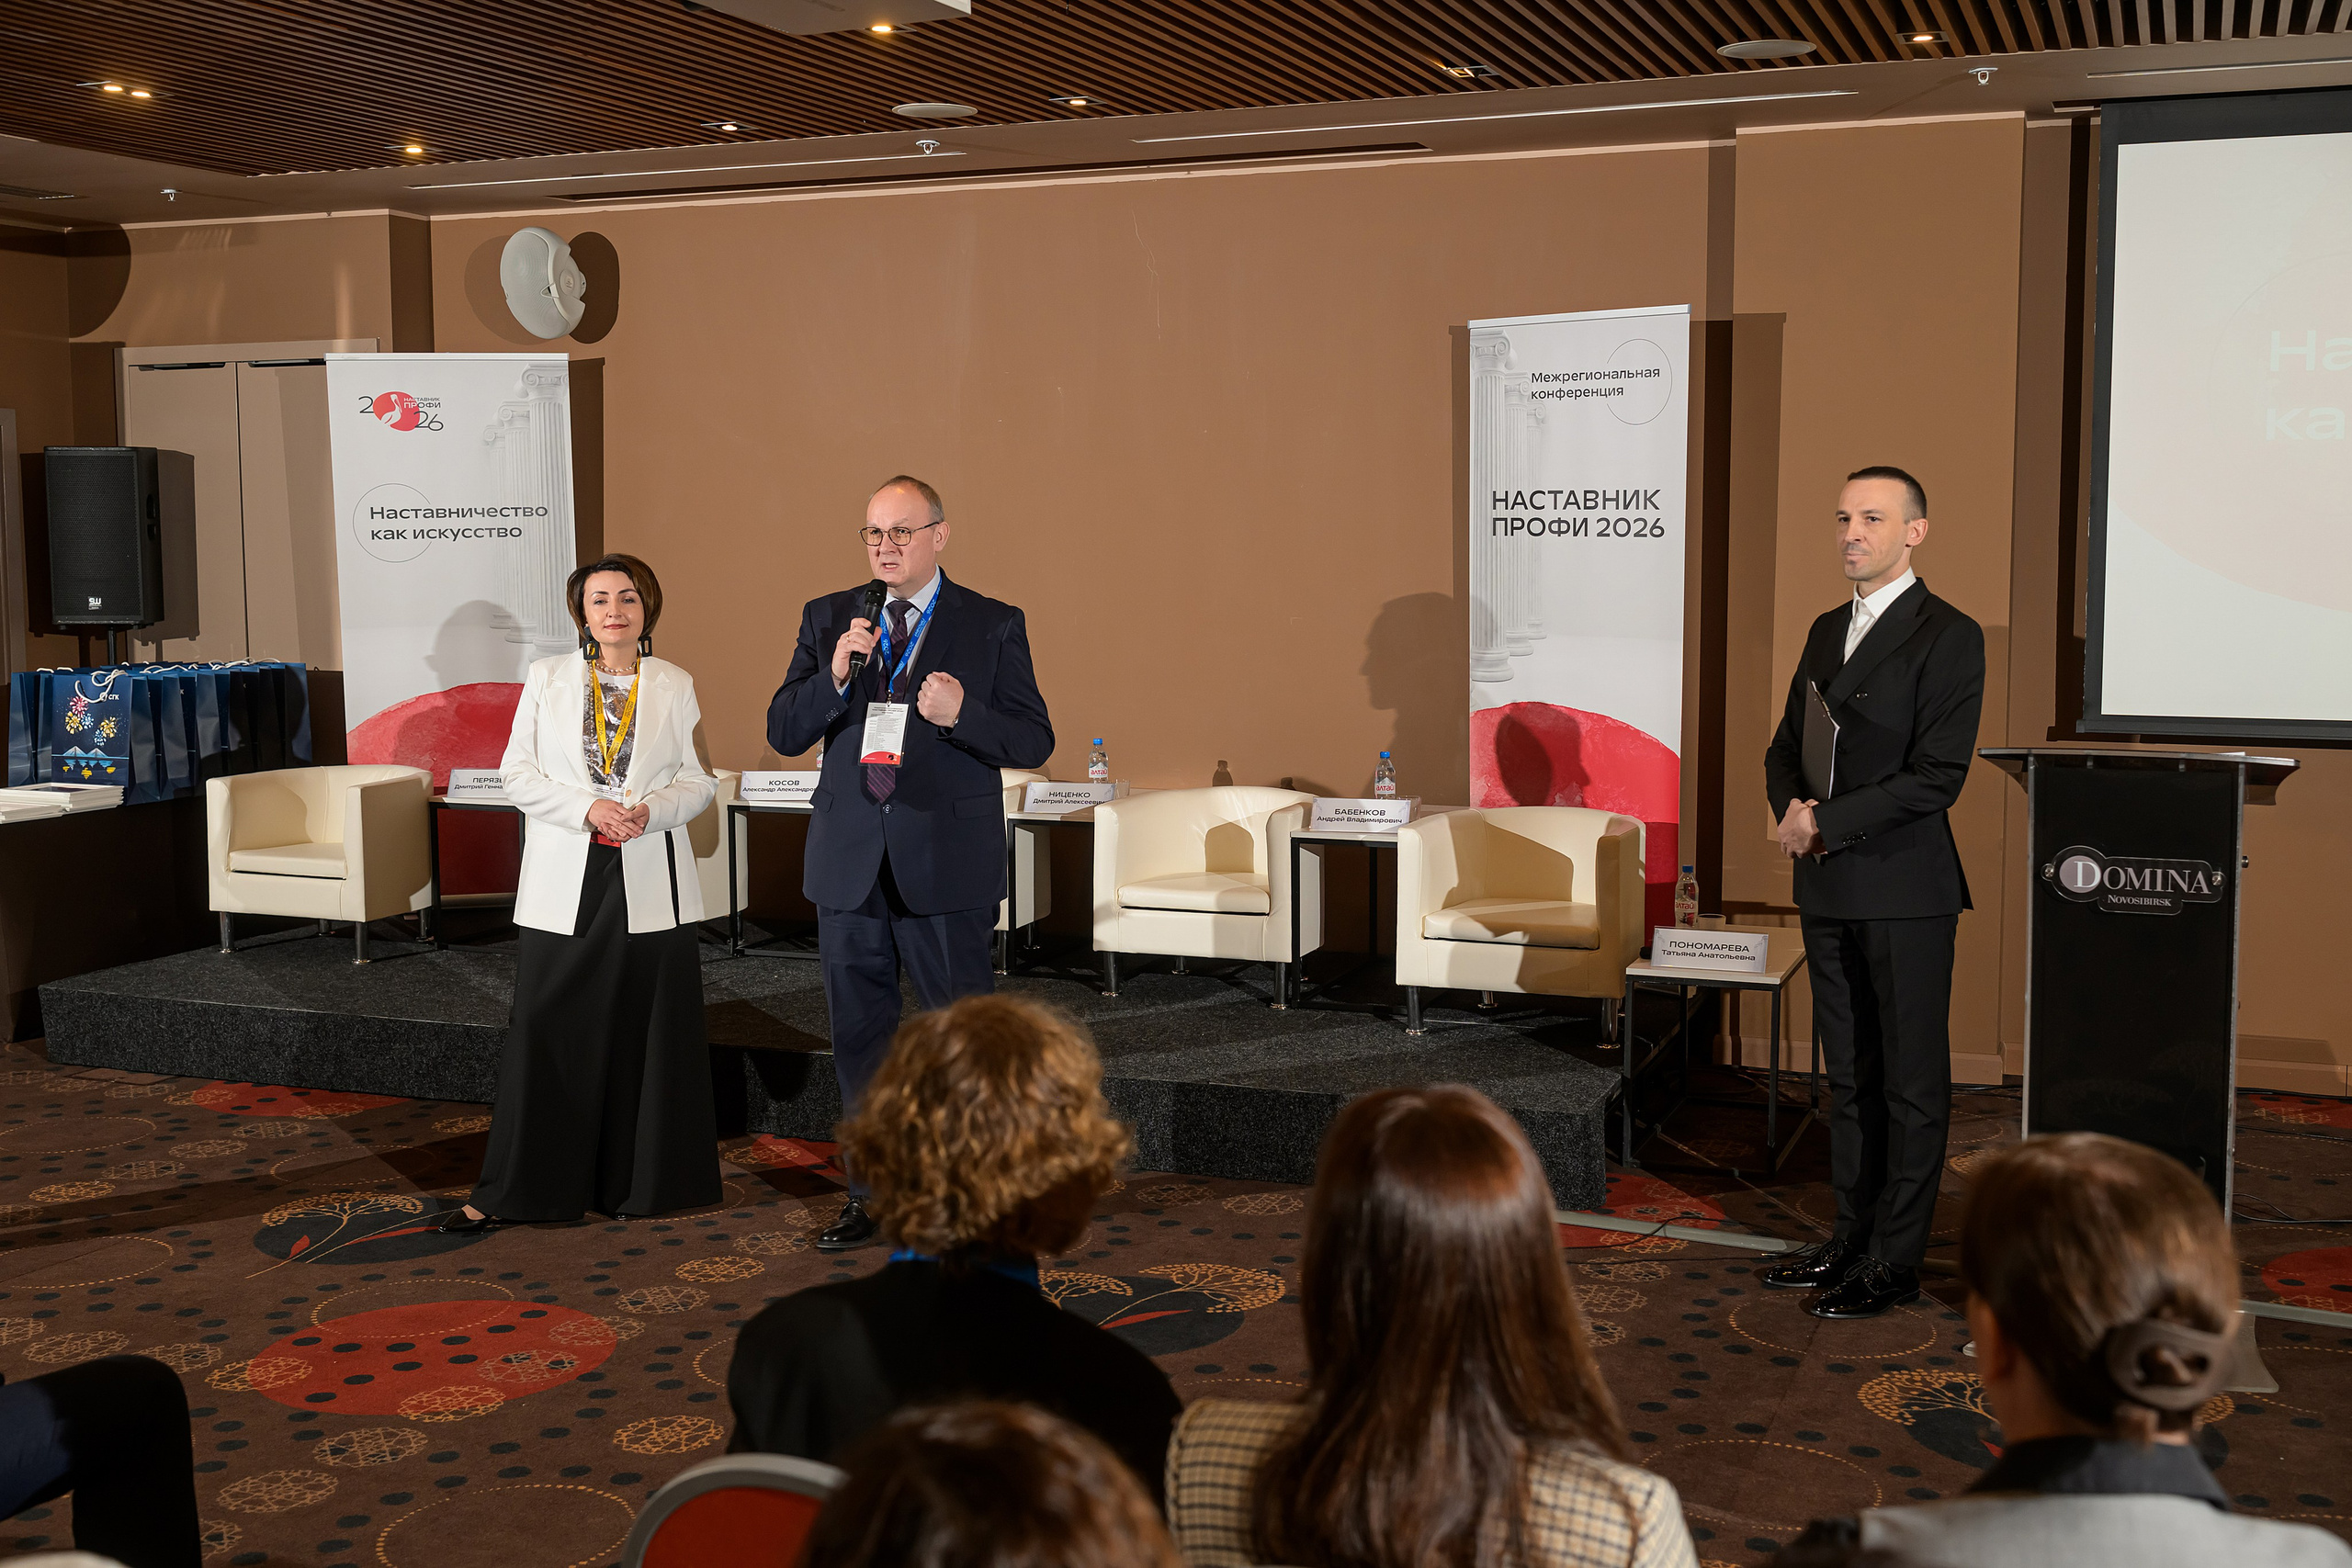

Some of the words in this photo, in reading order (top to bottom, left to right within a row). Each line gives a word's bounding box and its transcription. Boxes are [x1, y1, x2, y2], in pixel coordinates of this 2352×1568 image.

[1531, 368, 1660, 384] Межрегиональная
[1531, 386, 1624, 400] конференция
[1492, 489, 1661, 511] НАСТАВНИК
[369, 506, 548, 520] Наставничество
[370, 528, 407, 540] как
[413, 526, 523, 542] искусство
[1492, 517, 1589, 537] ПРОФИ
[1596, 517, 1665, 538] 2026
[926, 599, 937, 615] 2026
[905, 641, 915, 657] 2026
[617, 722, 628, 737] 2026
[1334, 808, 1386, 817] БАБЕНКОВ
[2074, 861, 2212, 895] DOMINA
[1668, 941, 1750, 953] ПОНОМАРЕВА
[1661, 949, 1696, 958] Татьяна
[1697, 951, 1756, 962] Анатольевна
